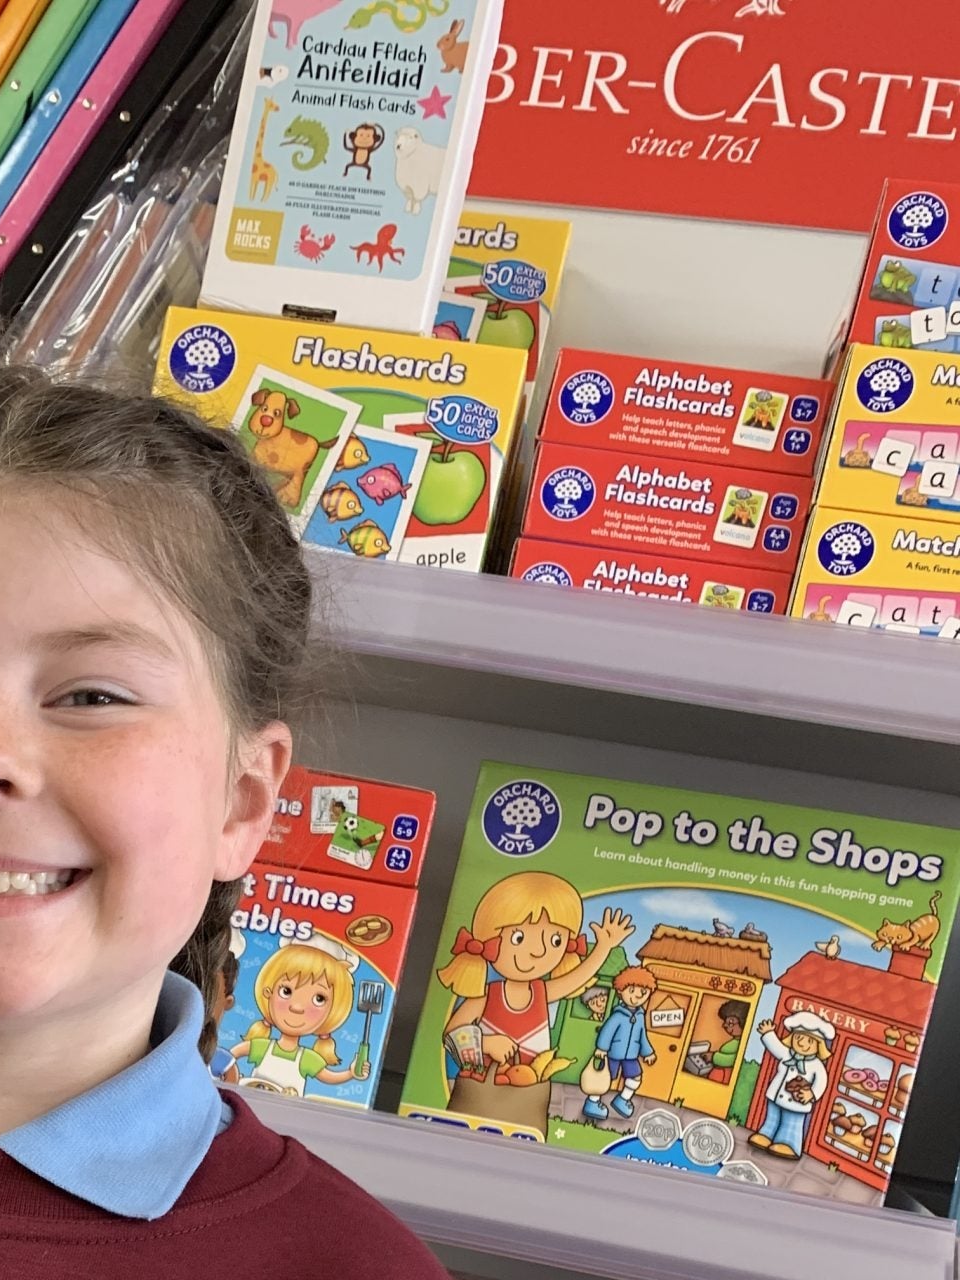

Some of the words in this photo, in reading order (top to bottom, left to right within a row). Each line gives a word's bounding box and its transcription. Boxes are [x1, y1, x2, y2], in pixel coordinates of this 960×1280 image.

[302, 35, 367, 59] Cardiau
[372, 42, 427, 64] Fflach
[297, 55, 424, 90] Anifeiliaid
[291, 90, 336, 107] Animal
[339, 93, 375, 112] Flash
[378, 98, 416, 116] Cards
[627, 129, 691, 159] since
[699, 133, 761, 164] 1761
[896, 194, 944, 218] ORCHARD
[236, 218, 261, 232] MAX
[454, 222, 517, 250] ards
[233, 233, 272, 250] ROCKS
[899, 234, 928, 247] TOYS
[484, 263, 514, 286] 50
[509, 284, 540, 298] cards
[177, 327, 232, 356] ORCHARD
[293, 336, 467, 386] Flashcards
[864, 360, 911, 382] ORCHARD
[182, 376, 215, 392] TOYS
[566, 373, 611, 396] ORCHARD
[634, 368, 733, 397] Alphabet
[428, 399, 461, 426] 50
[464, 403, 496, 418] extra
[624, 387, 735, 418] Flashcards
[867, 398, 896, 412] TOYS
[461, 412, 493, 429] large
[570, 410, 596, 422] TOYS
[622, 413, 640, 424] Help
[642, 415, 665, 427] teach
[695, 423, 726, 435] phonics
[457, 424, 492, 440] cards
[609, 432, 627, 441] with
[628, 434, 650, 445] these
[652, 438, 686, 449] versatile
[688, 442, 730, 455] flashcards
[623, 424, 639, 433] and
[640, 425, 668, 437] speech
[669, 430, 720, 444] development
[548, 469, 591, 491] ORCHARD
[616, 464, 712, 494] Alphabet
[605, 484, 715, 515] Flashcards
[551, 505, 578, 519] TOYS
[825, 524, 872, 547] ORCHARD
[416, 549, 467, 567] apple
[828, 562, 856, 575] TOYS
[525, 565, 569, 586] ORCHARD
[592, 560, 689, 590] Alphabet
[933, 565, 950, 575] first
[493, 784, 556, 815] ORCHARD
[496, 836, 536, 855] TOYS
[583, 794, 664, 845] Pop
[674, 811, 718, 846] to
[727, 815, 800, 859] the
[807, 828, 944, 886] Shops
[593, 847, 626, 862] Learn
[628, 853, 664, 868] about
[665, 858, 716, 878] handling
[718, 869, 758, 885] money
[760, 874, 771, 884] in
[774, 876, 796, 890] this
[799, 879, 819, 893] fun
[821, 884, 877, 904] shopping
[879, 894, 914, 908] game
[264, 872, 355, 913] Times
[653, 1012, 682, 1023] OPEN
[644, 1122, 676, 1145] 20p
[691, 1133, 722, 1157] 10p
